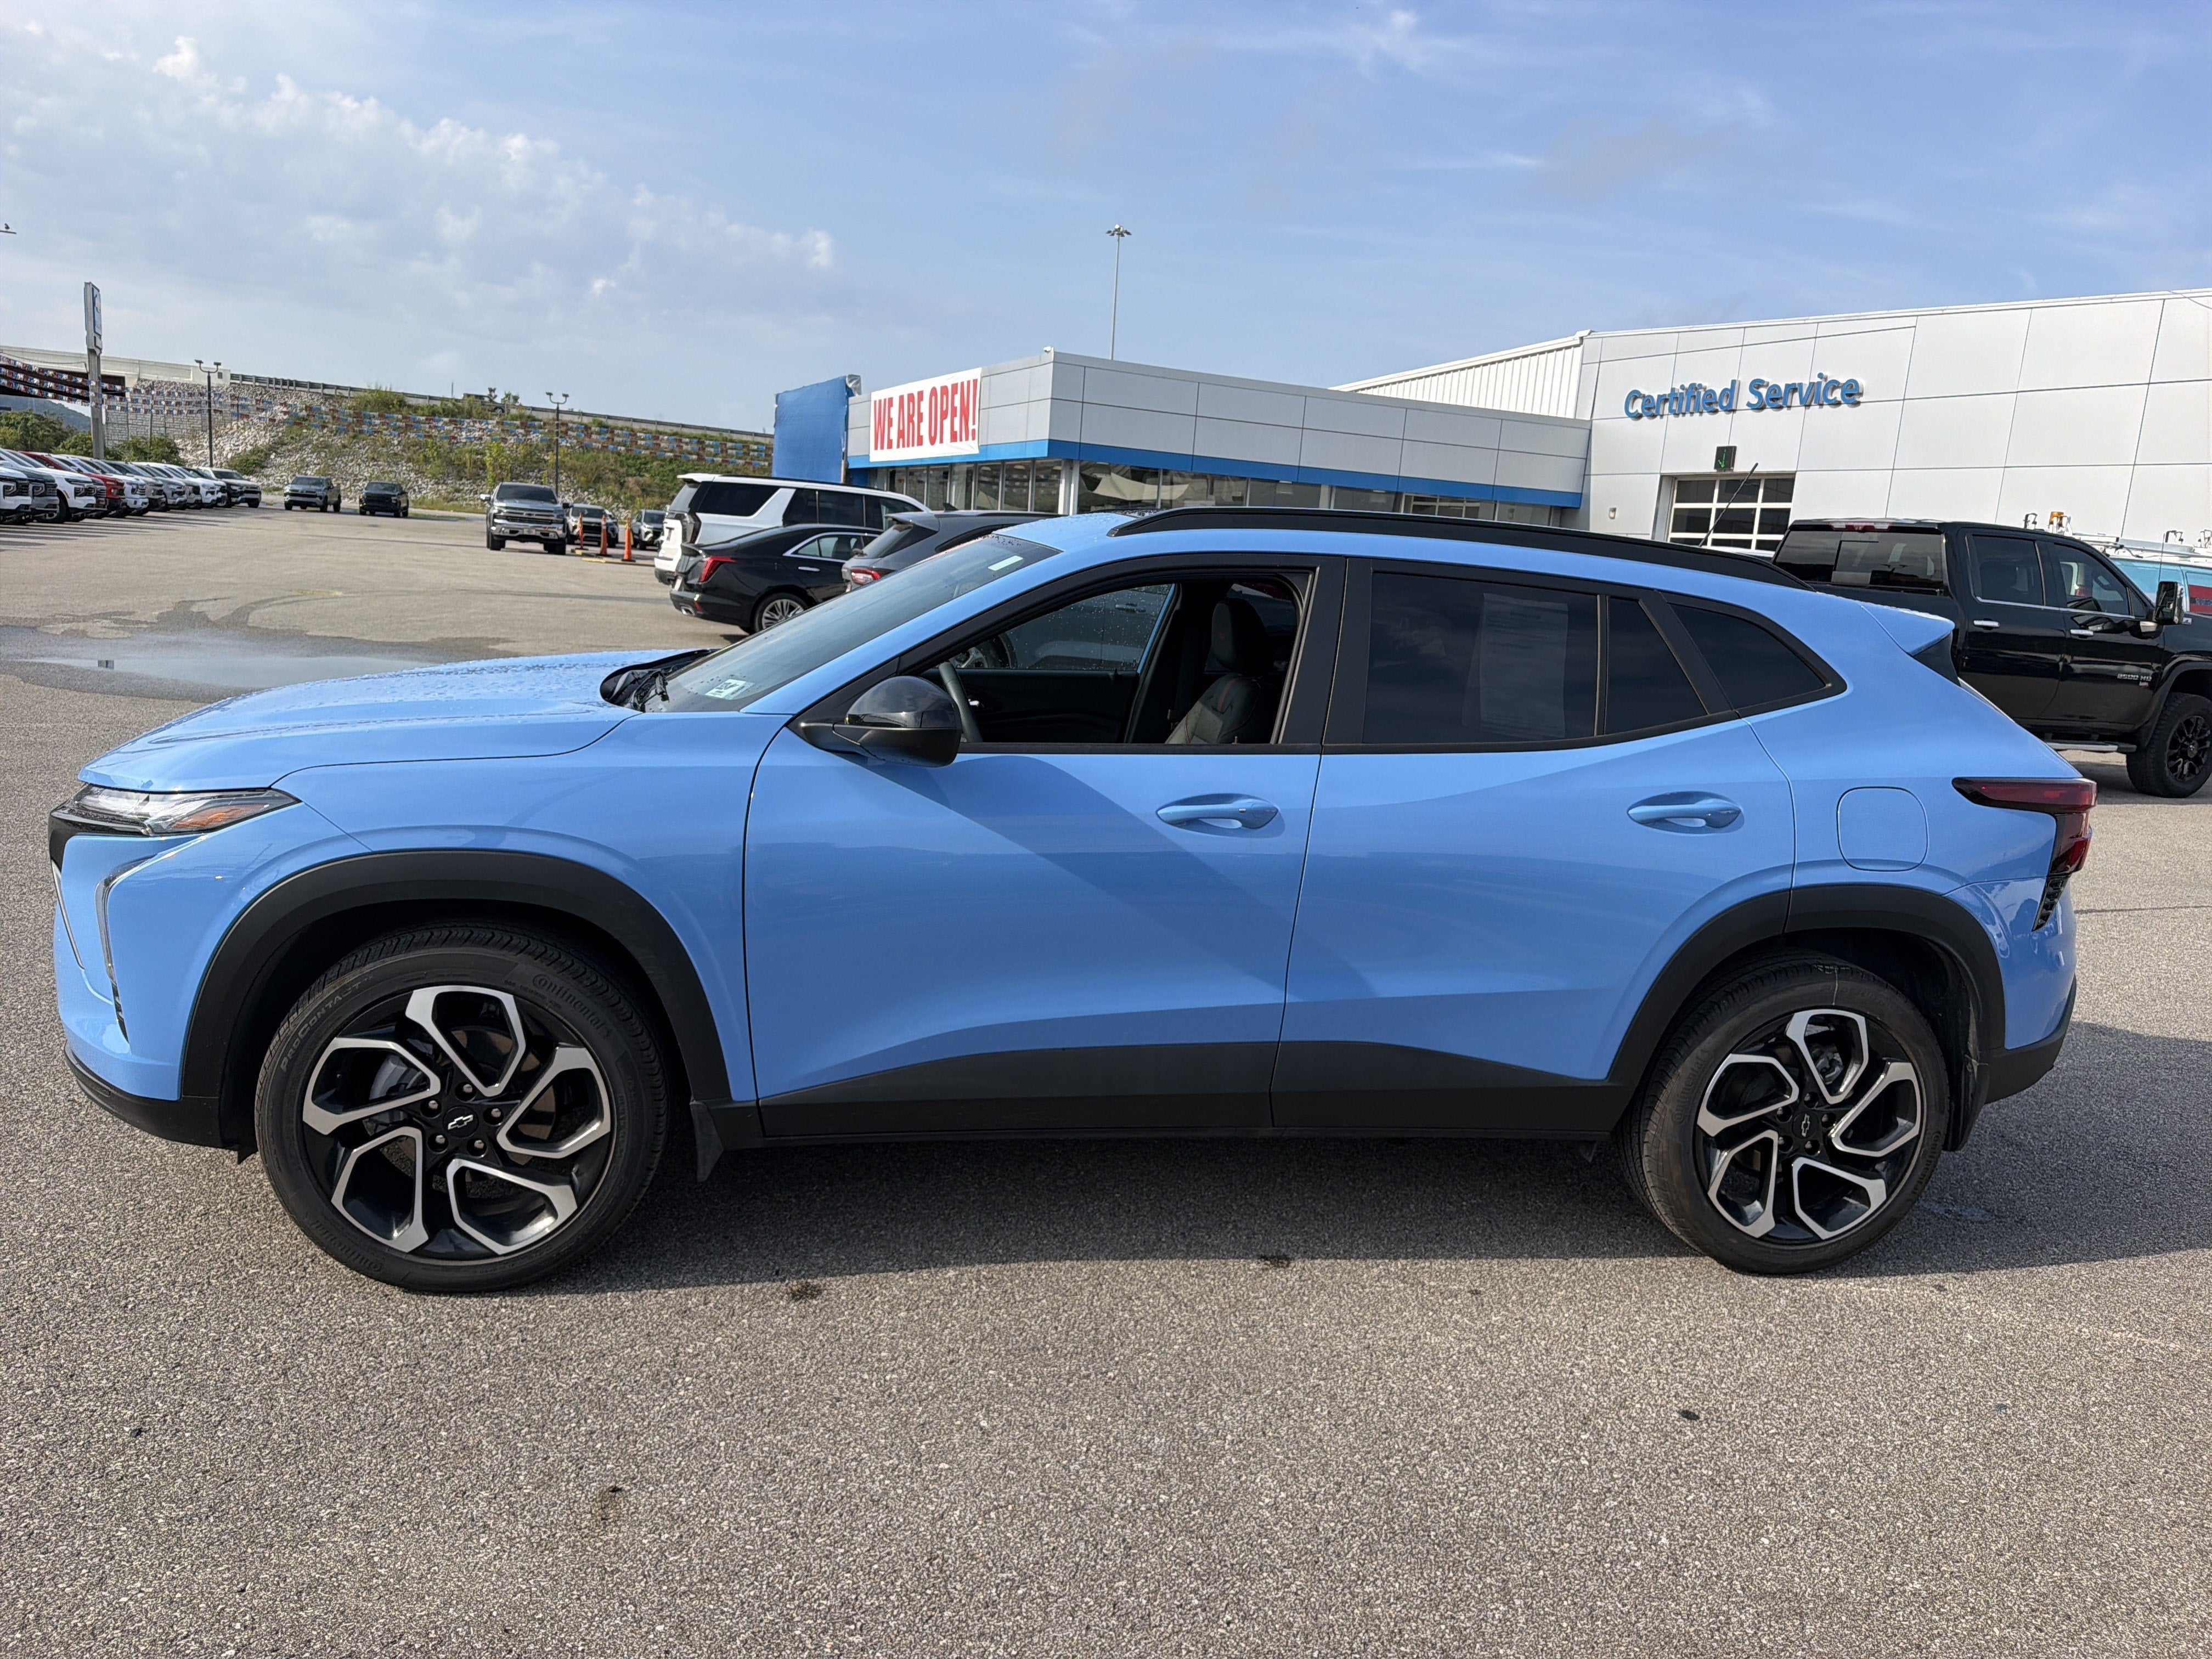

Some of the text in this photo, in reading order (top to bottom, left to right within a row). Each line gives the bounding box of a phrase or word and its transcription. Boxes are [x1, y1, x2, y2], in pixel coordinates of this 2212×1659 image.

[874, 379, 978, 450] WE ARE OPEN!
[1624, 373, 1860, 418] Certified Service
[532, 974, 606, 1030] Continental
